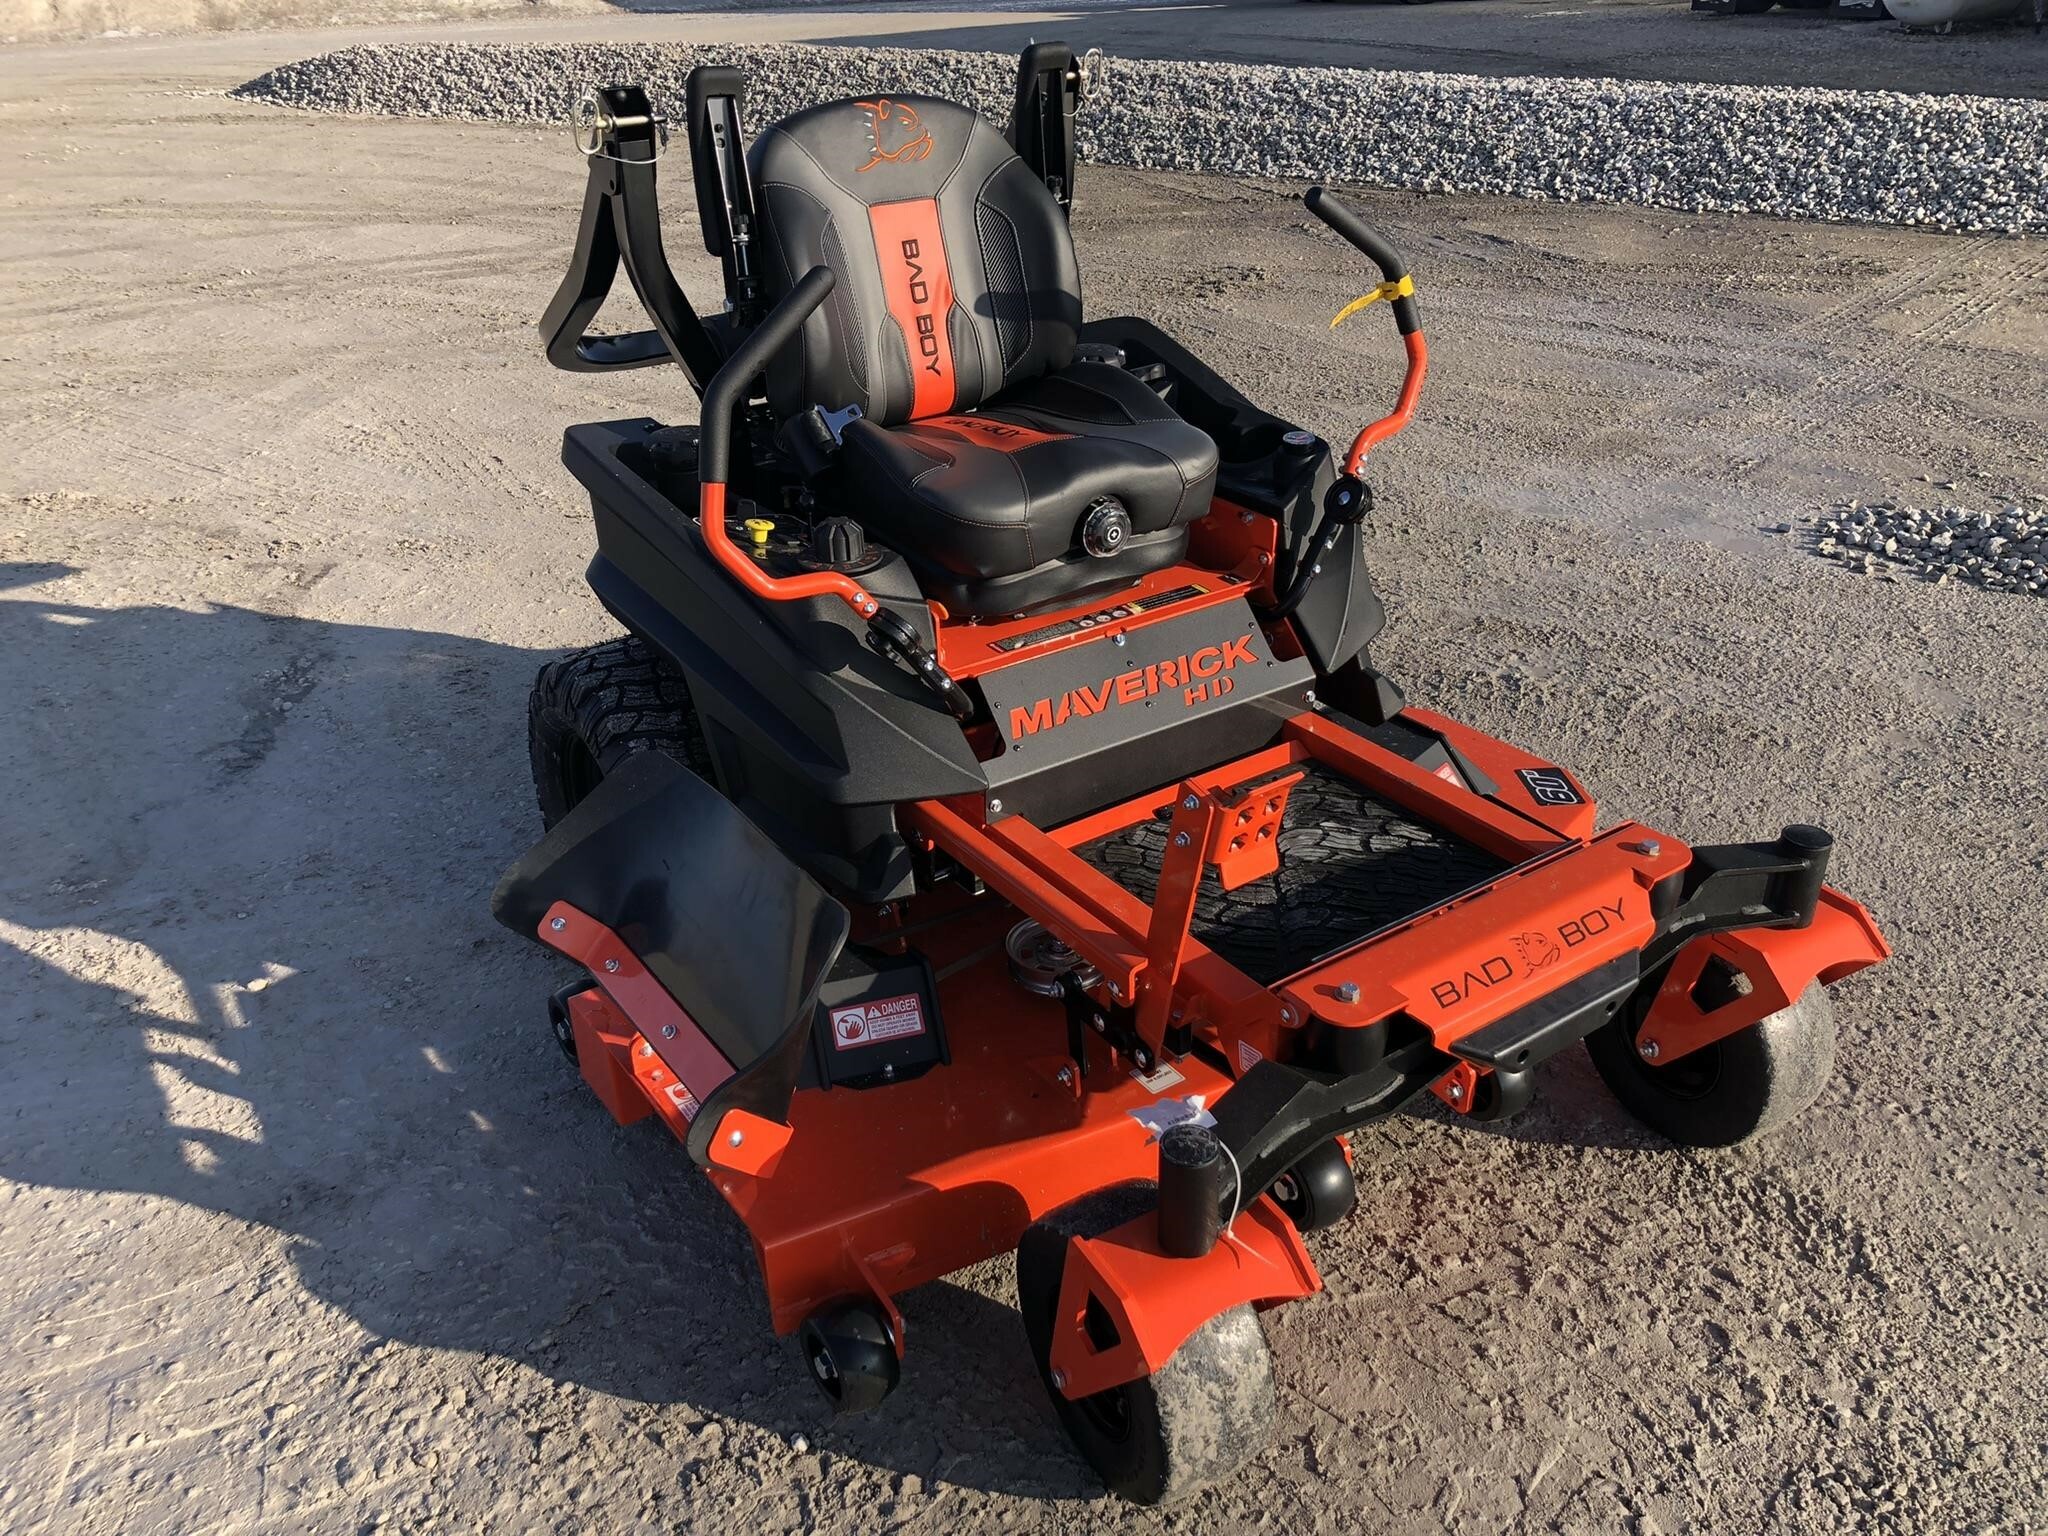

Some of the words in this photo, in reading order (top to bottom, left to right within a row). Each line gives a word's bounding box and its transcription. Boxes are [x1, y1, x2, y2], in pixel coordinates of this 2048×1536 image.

[901, 239, 928, 304] BAD
[916, 313, 941, 377] BOY
[1009, 634, 1259, 740] MAVERICK
[1184, 675, 1234, 708] HD
[1430, 956, 1513, 1009] BAD
[1557, 896, 1625, 948] BOY
[881, 998, 918, 1016] DANGER
